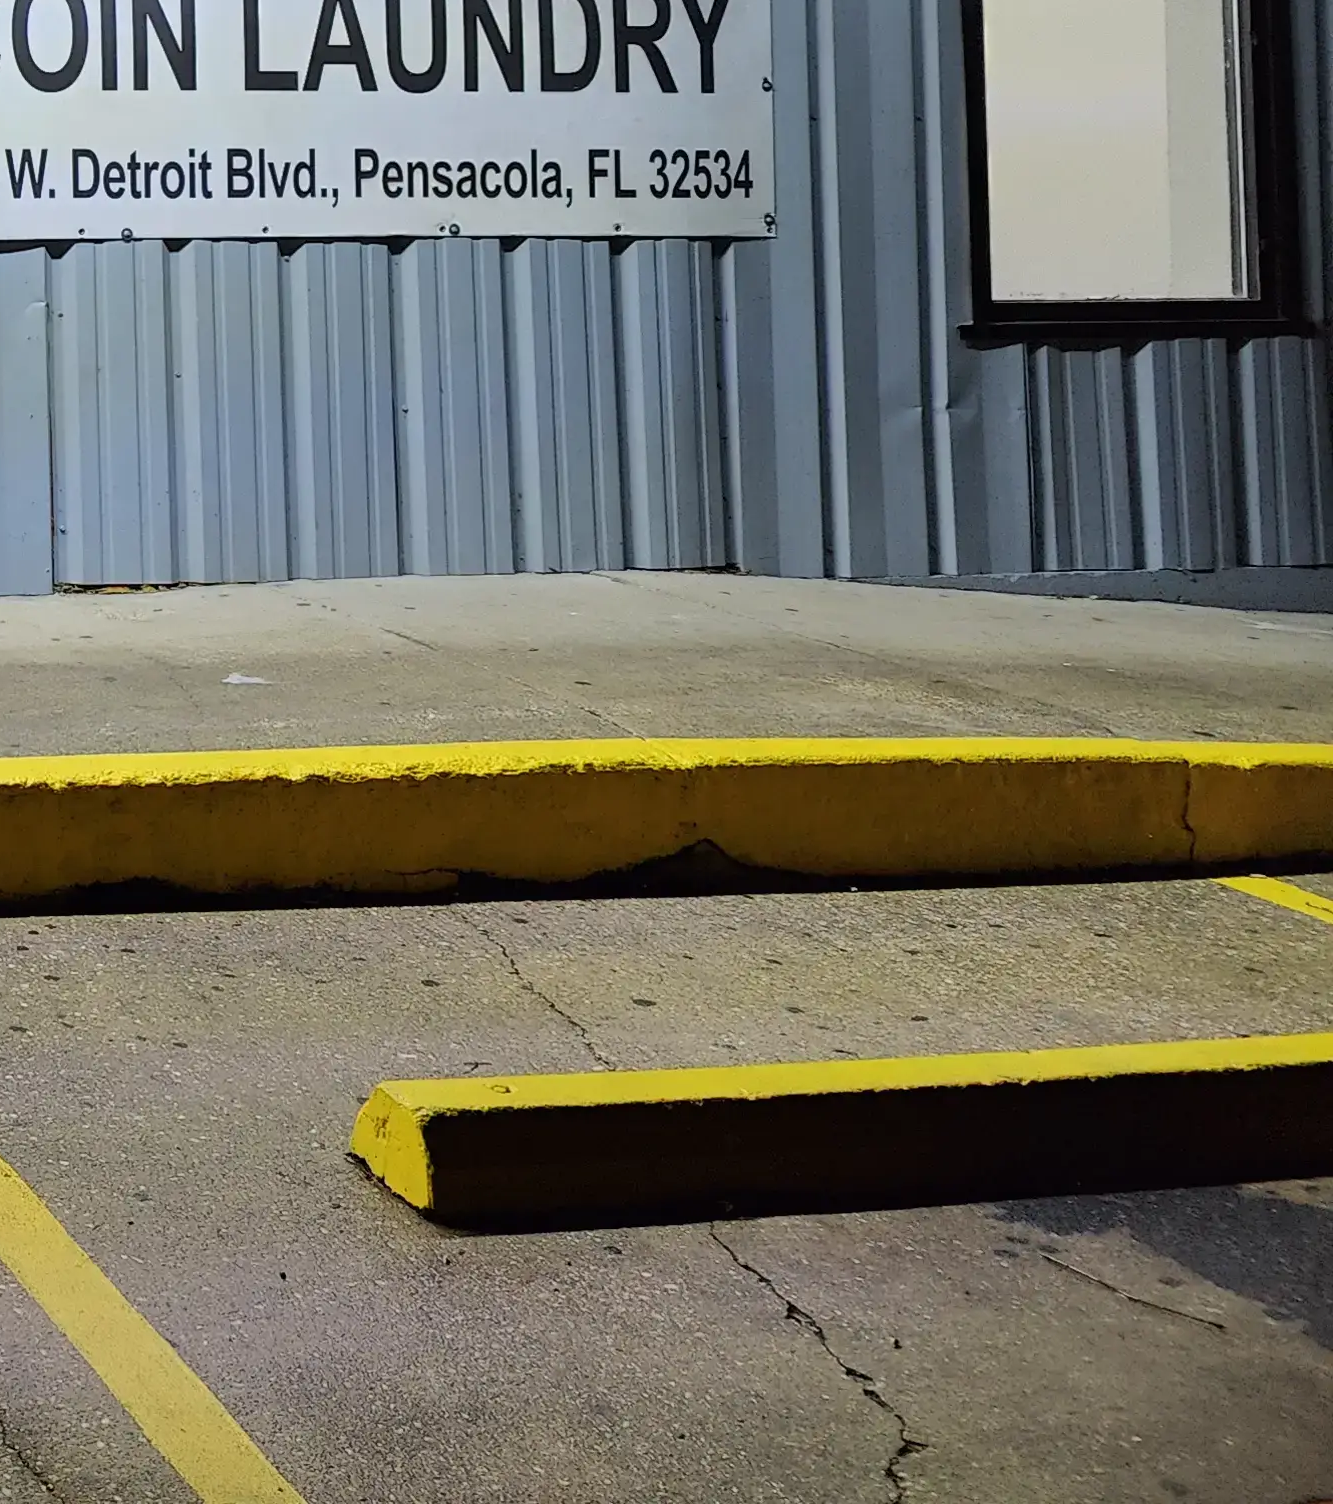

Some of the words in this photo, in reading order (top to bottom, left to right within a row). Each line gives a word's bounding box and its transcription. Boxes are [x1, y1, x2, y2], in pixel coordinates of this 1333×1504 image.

[4, 148, 56, 199] W.
[71, 148, 214, 200] Detroit
[226, 148, 339, 208] Blvd.,
[354, 148, 573, 208] Pensacola,
[588, 148, 637, 199] FL
[648, 148, 754, 200] 32534
